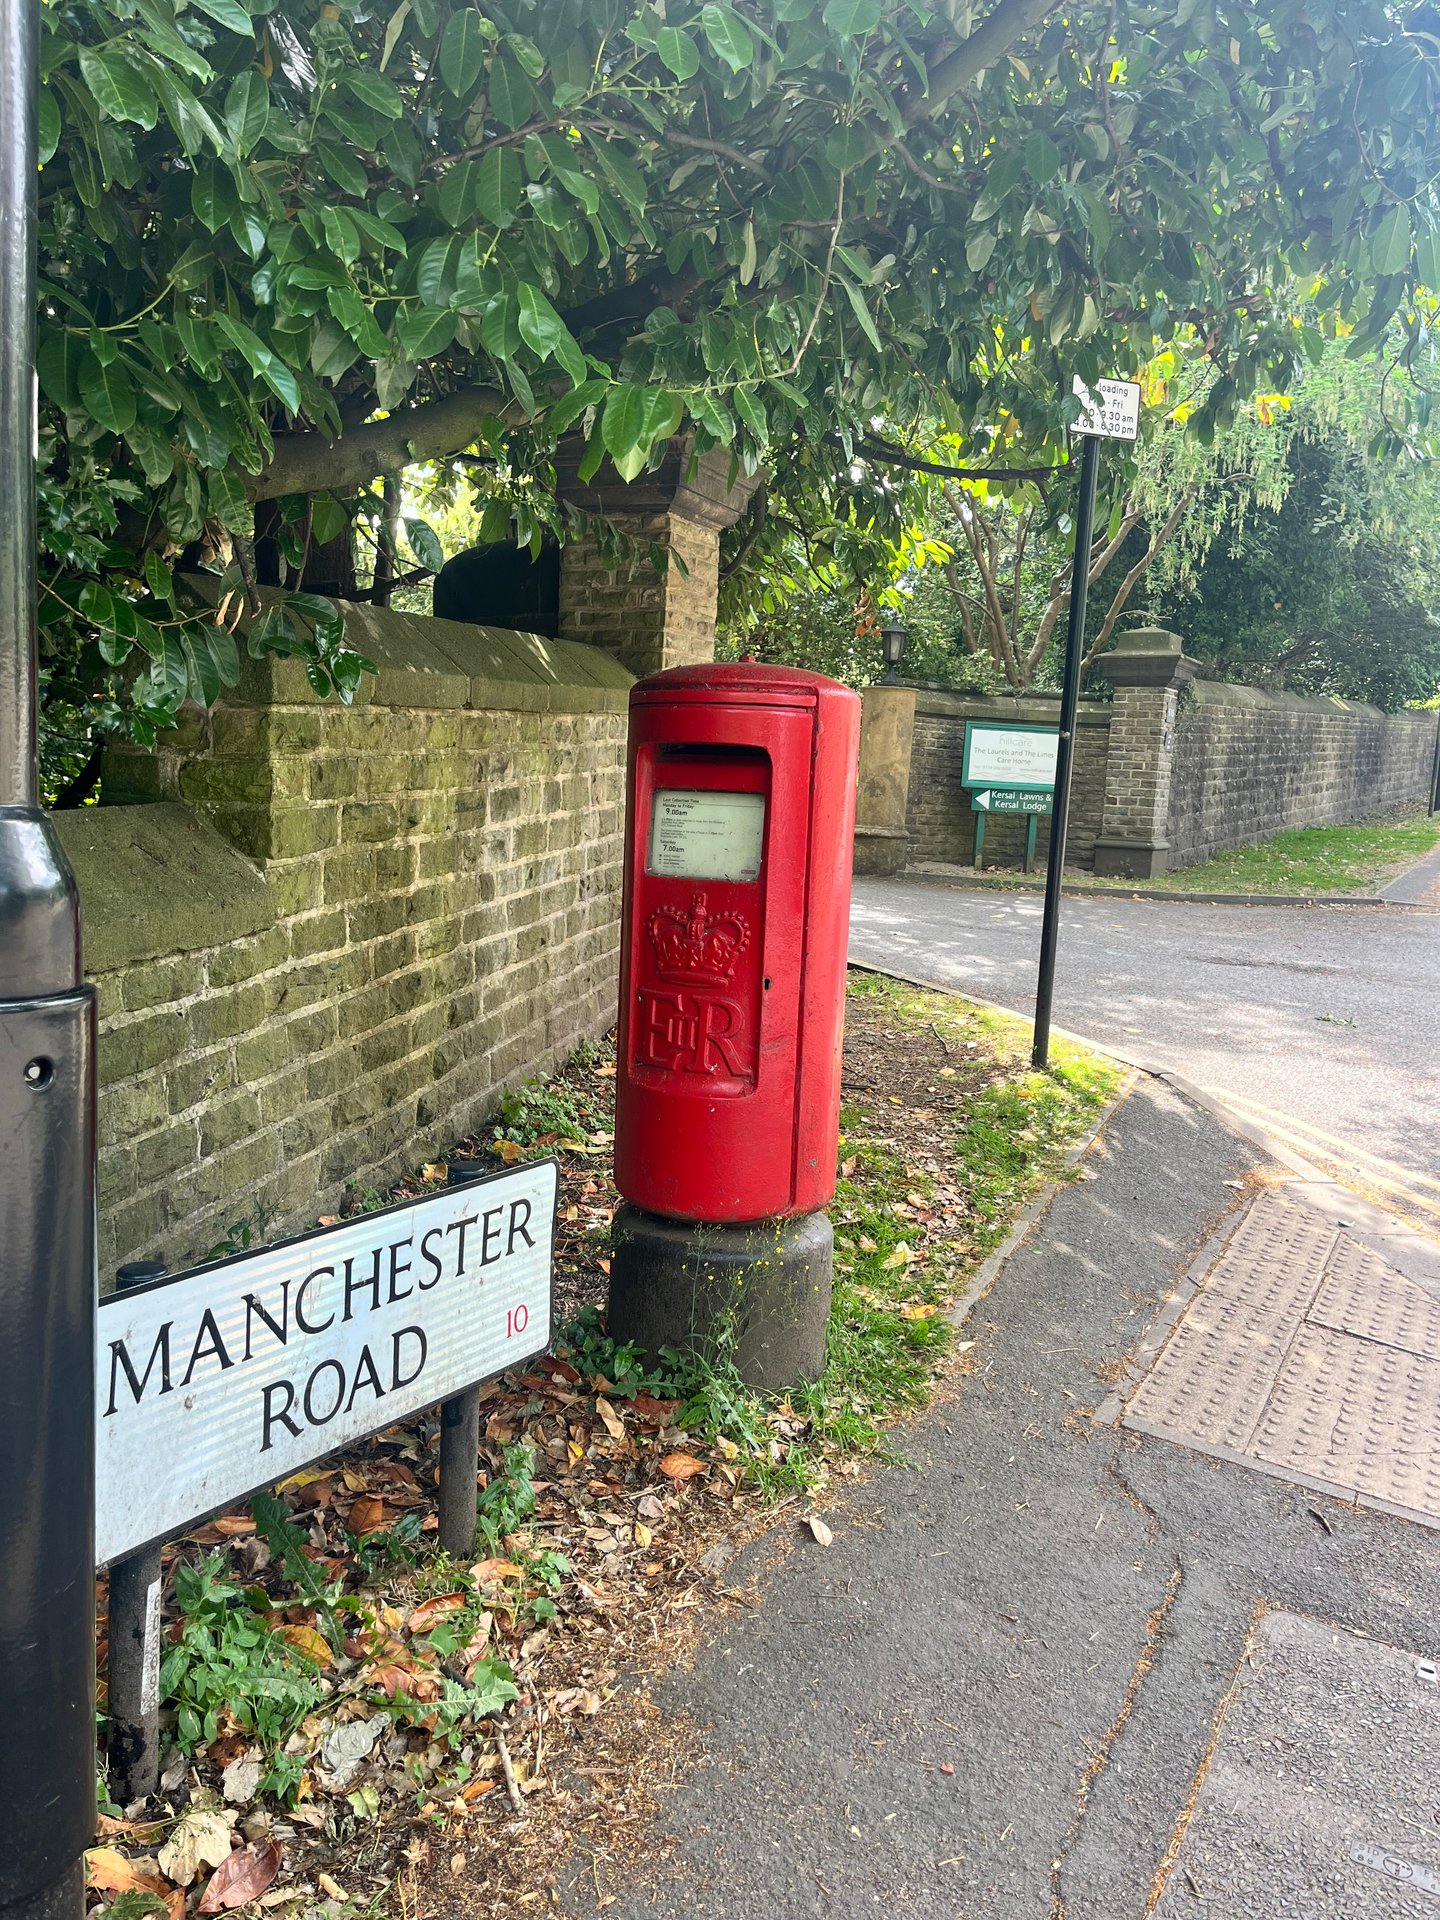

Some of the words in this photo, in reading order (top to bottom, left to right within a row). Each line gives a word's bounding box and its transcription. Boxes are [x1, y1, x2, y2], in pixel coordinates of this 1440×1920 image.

[1099, 383, 1128, 397] loading
[1113, 399, 1123, 408] Fri
[1101, 410, 1120, 421] 9.30
[1122, 415, 1133, 423] am
[1074, 418, 1094, 429] 4.0
[1101, 421, 1120, 432] 630
[1000, 736, 1033, 747] hillcare
[991, 791, 1015, 799] Kersal
[1019, 792, 1044, 801] Lawns
[665, 808, 688, 816] 9.00am
[995, 800, 1019, 809] Kersal
[1023, 802, 1047, 812] Lodge
[663, 844, 685, 853] 7.00am
[102, 1198, 537, 1418] MANCHESTER
[506, 1303, 529, 1339] 10
[259, 1325, 428, 1453] ROAD
